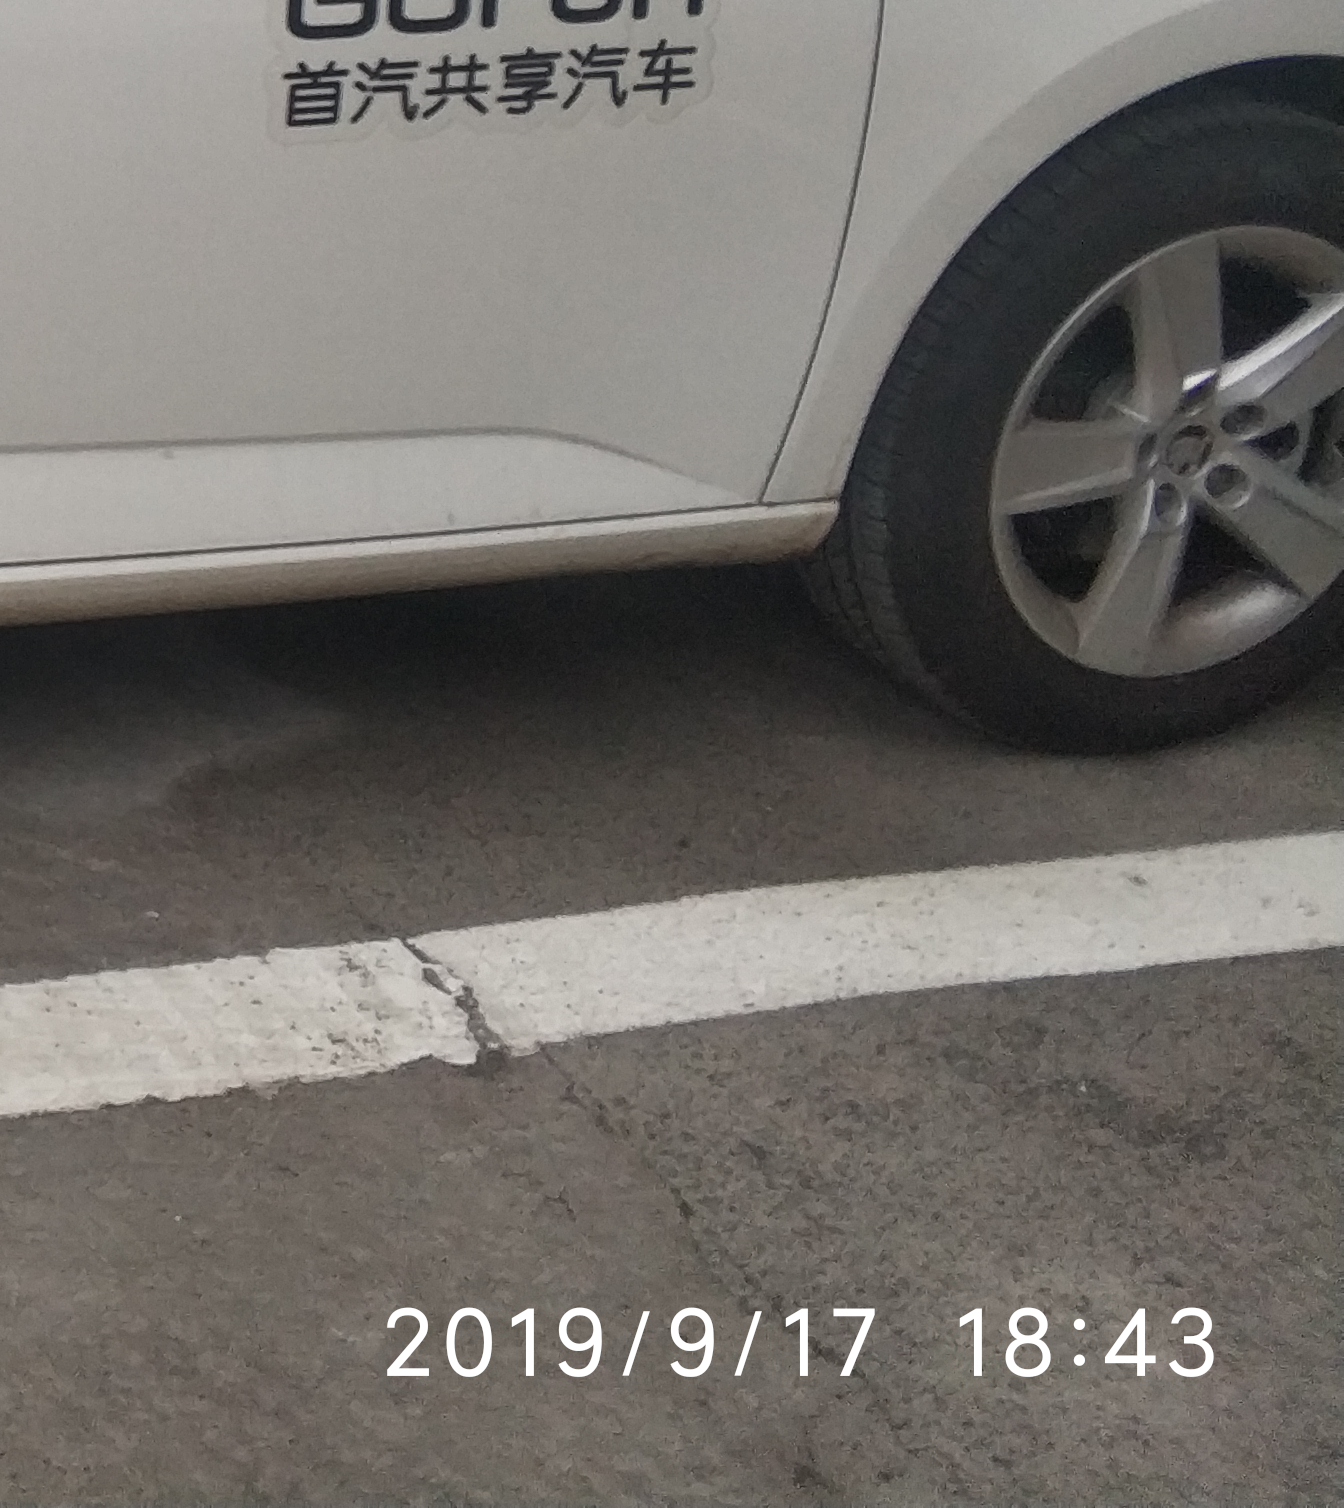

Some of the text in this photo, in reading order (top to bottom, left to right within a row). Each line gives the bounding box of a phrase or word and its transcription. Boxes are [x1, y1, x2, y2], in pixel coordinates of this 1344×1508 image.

[282, 38, 698, 127] 首汽共享汽车
